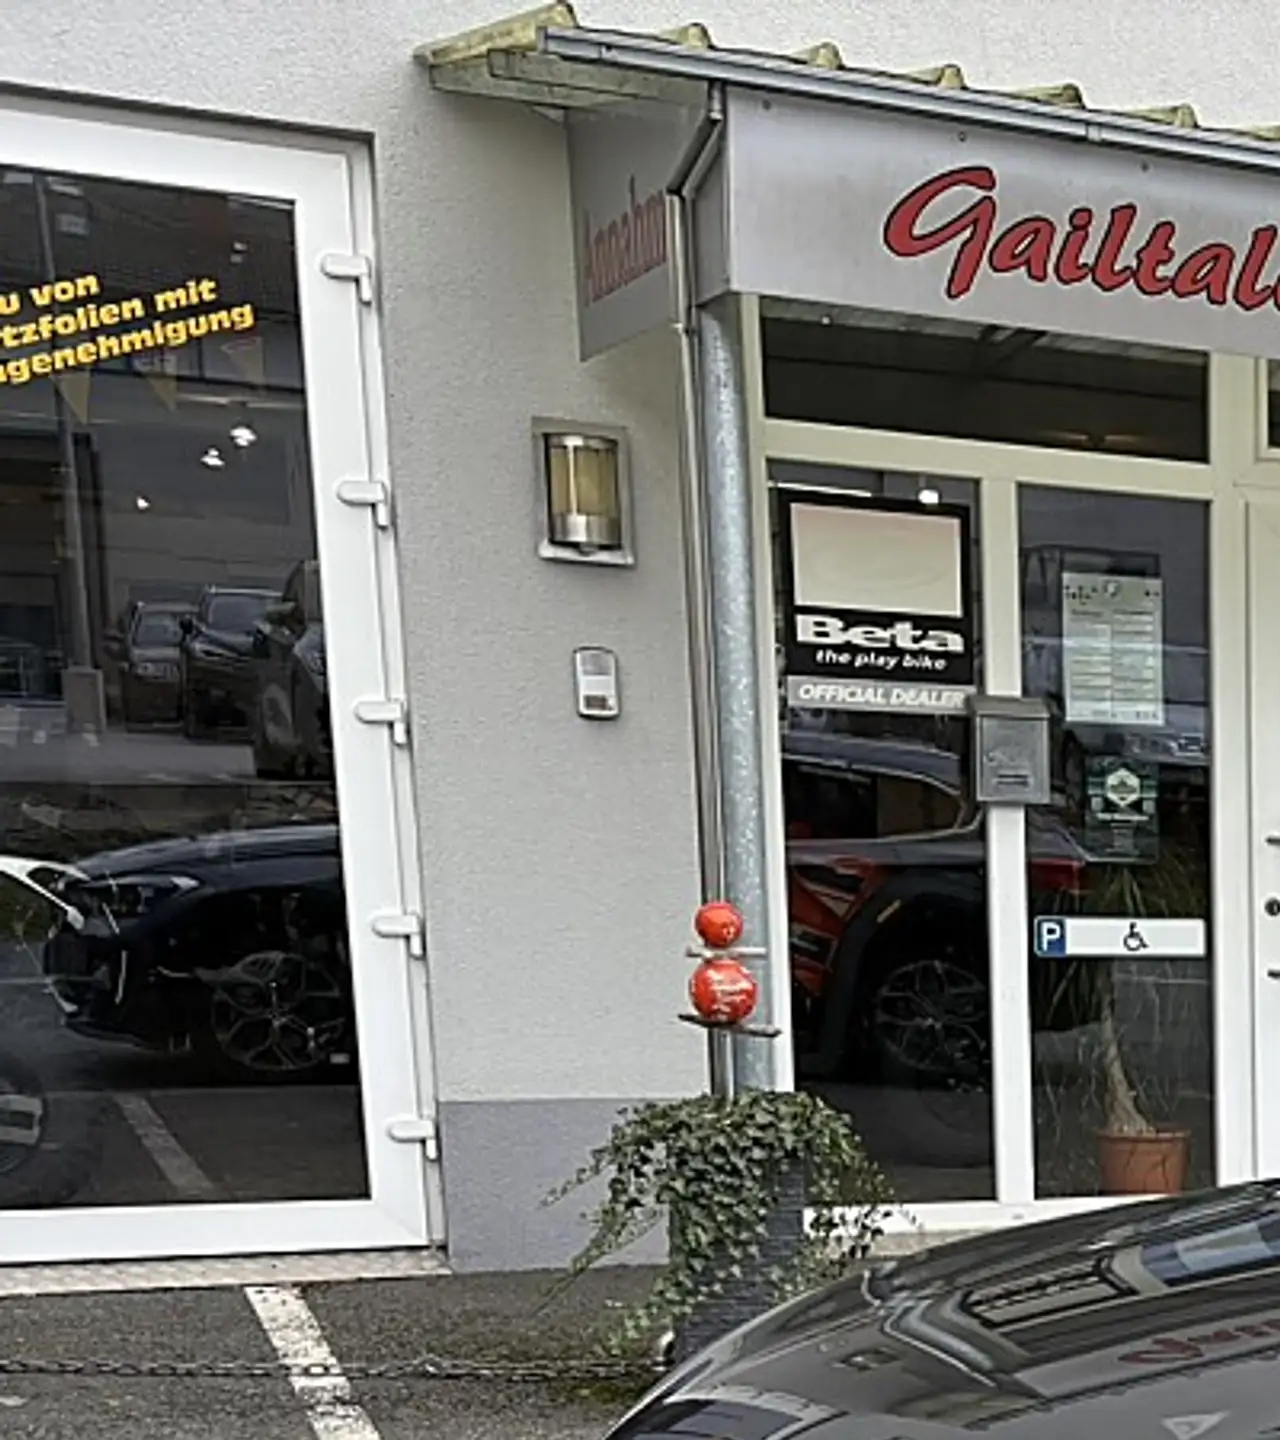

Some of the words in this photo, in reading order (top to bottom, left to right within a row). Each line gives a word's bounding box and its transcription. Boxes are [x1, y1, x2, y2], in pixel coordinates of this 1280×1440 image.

[29, 273, 101, 307] von
[153, 278, 218, 312] mit
[796, 614, 966, 653] Beta
[816, 649, 850, 664] the
[854, 652, 899, 670] play
[902, 654, 948, 670] bike
[799, 684, 887, 702] OFFICIAL
[889, 687, 967, 709] DEALER
[1041, 921, 1061, 952] P
